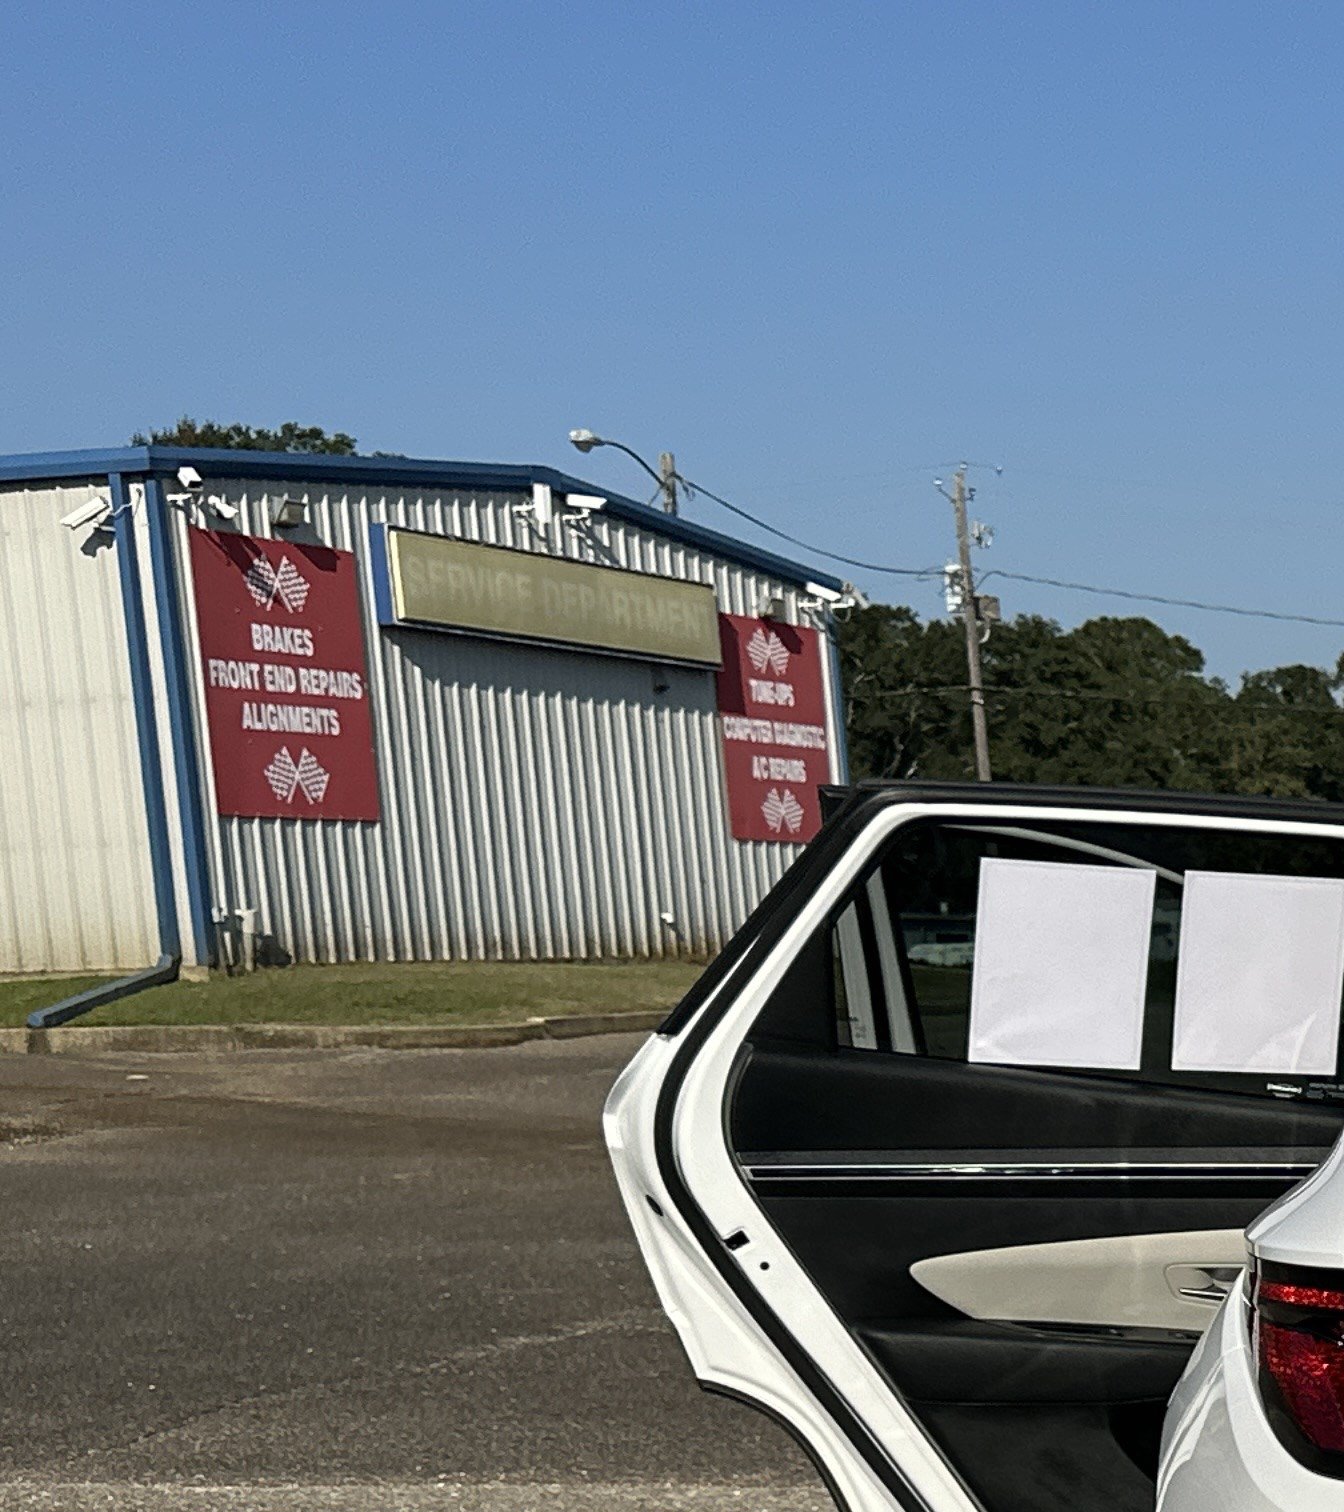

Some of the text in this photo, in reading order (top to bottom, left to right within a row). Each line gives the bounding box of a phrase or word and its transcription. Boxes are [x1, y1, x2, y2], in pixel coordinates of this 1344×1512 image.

[404, 554, 533, 612] SERVICE
[251, 623, 314, 657] BRAKES
[208, 658, 363, 700] FRONT END REPAIRS
[749, 678, 795, 707] TUNE-UPS
[242, 702, 341, 736] ALIGNMENTS
[722, 715, 774, 744] COMPUTER
[752, 755, 807, 784] A/C REPAIRS
